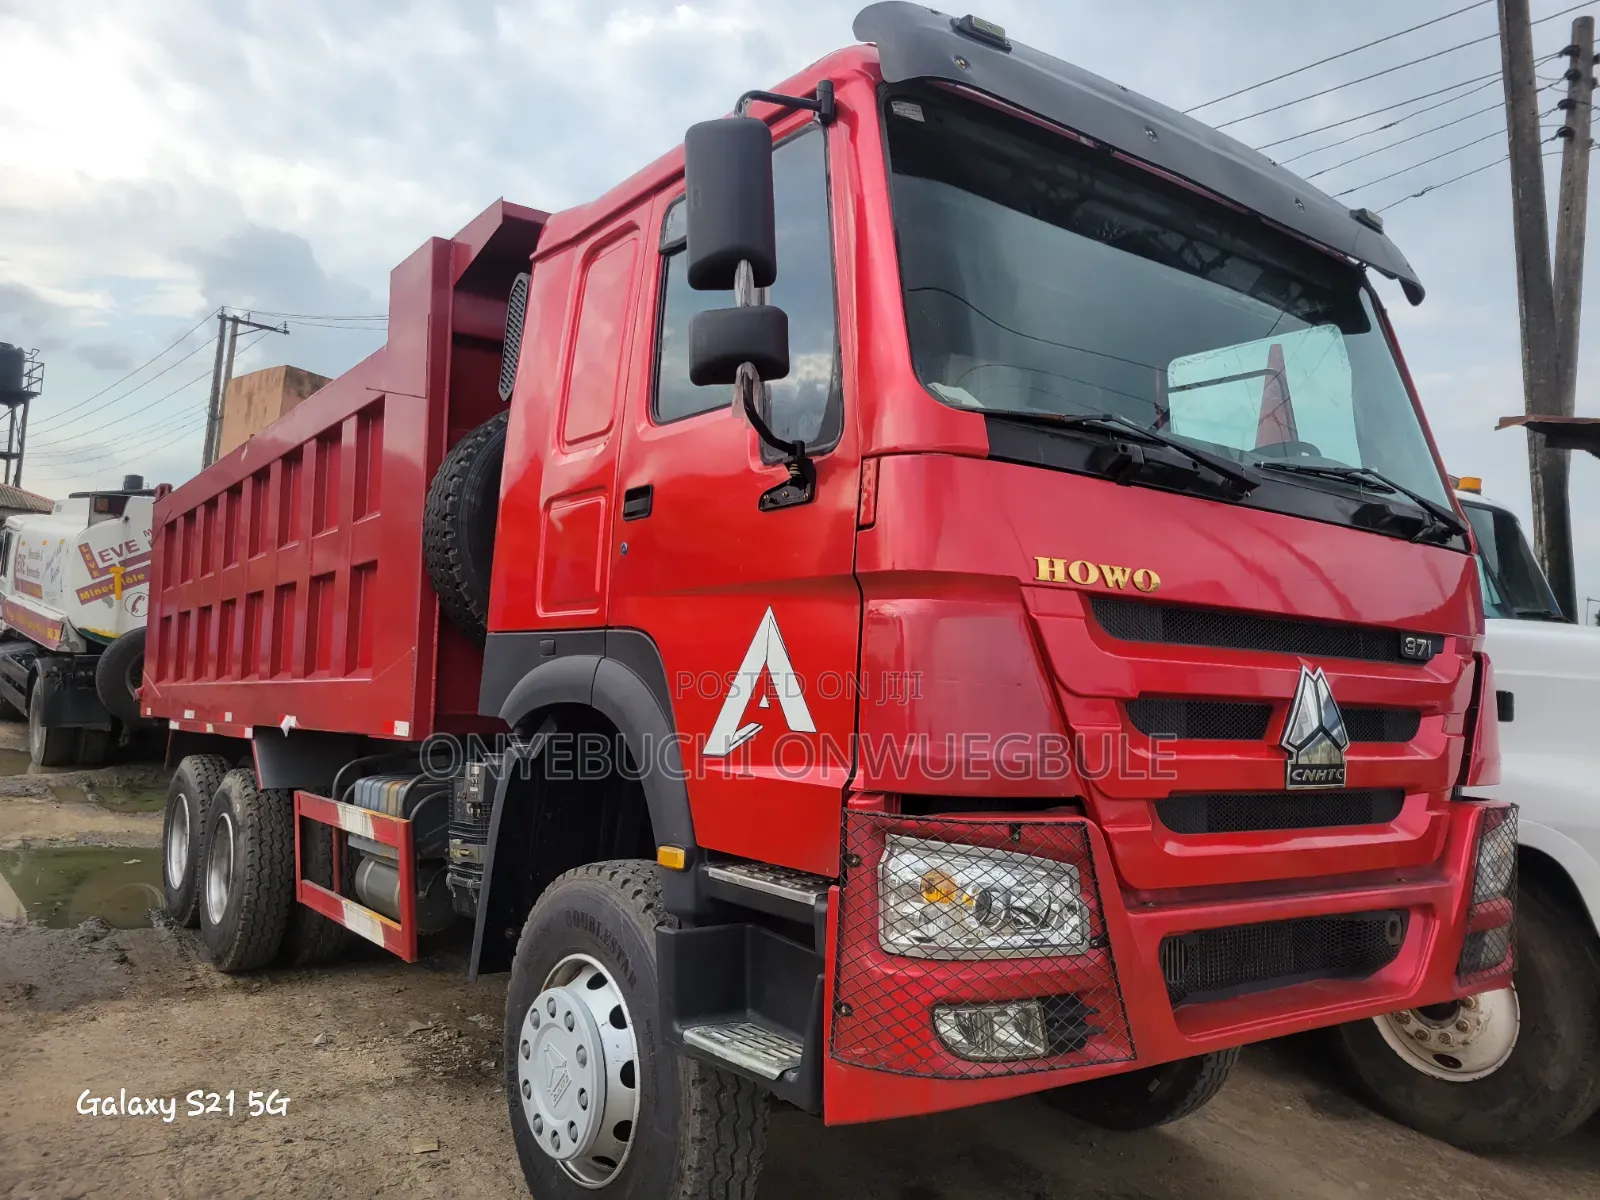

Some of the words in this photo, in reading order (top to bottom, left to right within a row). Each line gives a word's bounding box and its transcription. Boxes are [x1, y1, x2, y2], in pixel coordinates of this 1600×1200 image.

[81, 545, 100, 578] LEVE
[1033, 556, 1161, 593] HOWO
[1404, 637, 1432, 658] 371
[1291, 768, 1345, 782] CNHTC
[564, 909, 638, 991] DOUBLESTAR
